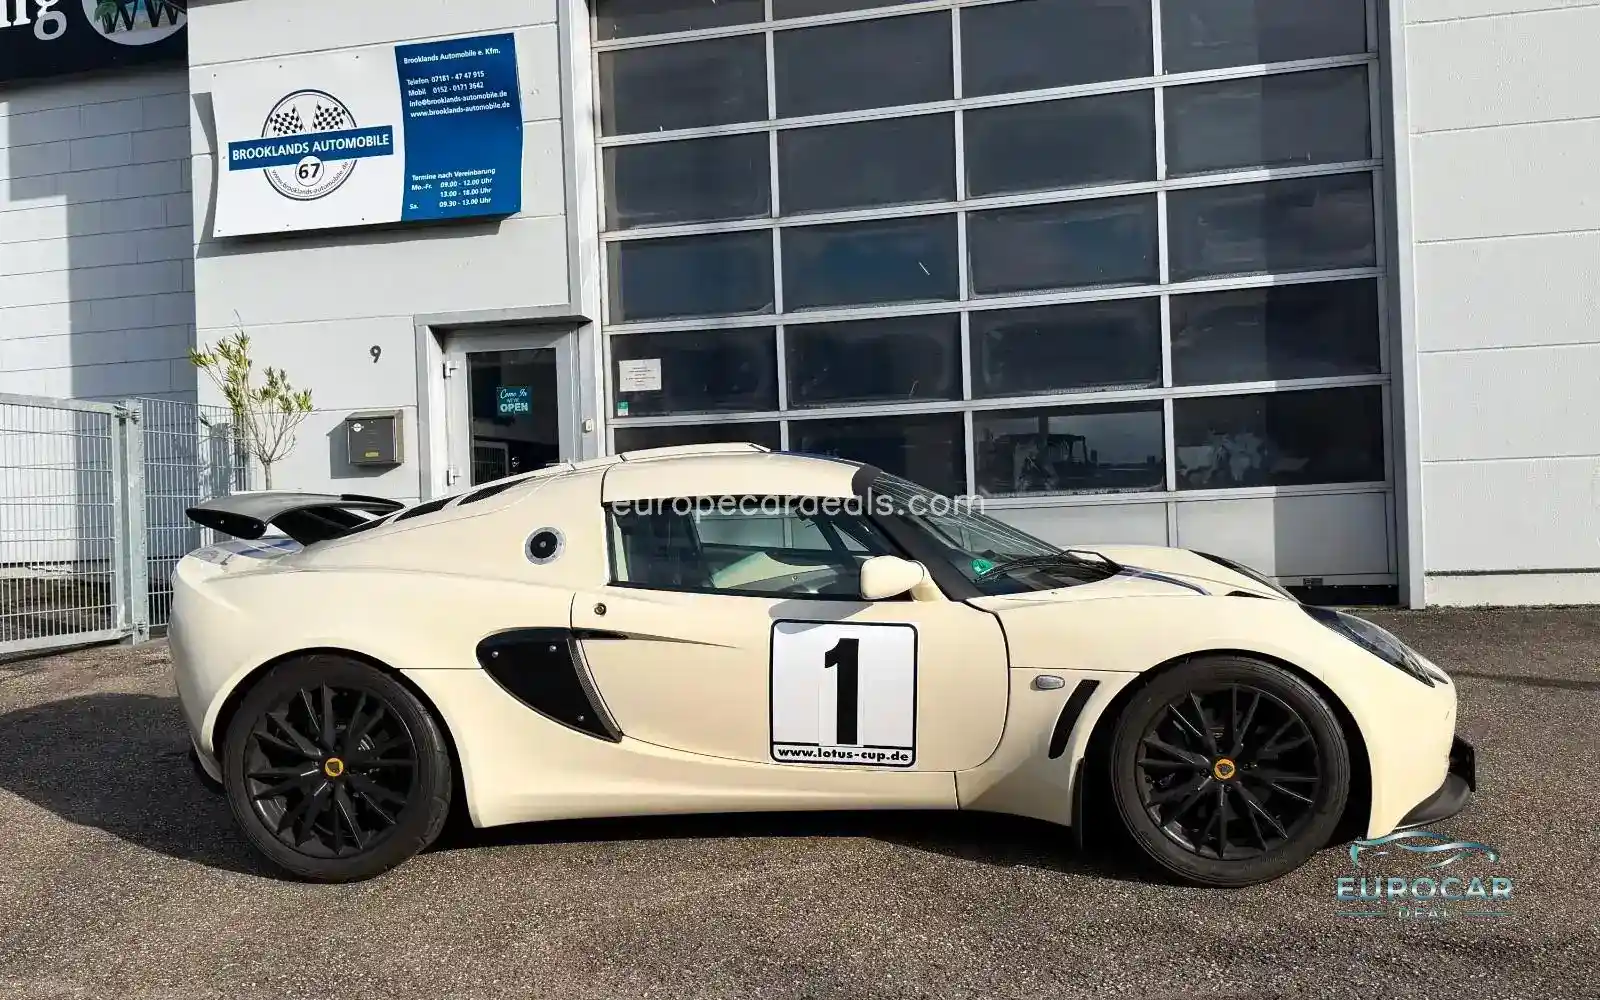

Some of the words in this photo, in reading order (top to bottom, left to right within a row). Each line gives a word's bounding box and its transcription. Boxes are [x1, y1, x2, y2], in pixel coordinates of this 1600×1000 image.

[403, 54, 439, 65] Brooklands
[440, 49, 477, 60] Automobile
[485, 47, 501, 56] Kfm.
[406, 78, 430, 86] Telefon
[431, 75, 450, 83] 07181
[464, 71, 472, 79] 47
[473, 70, 485, 78] 915
[408, 89, 427, 97] Mobil
[432, 85, 448, 94] 0152
[468, 81, 484, 90] 3642
[409, 90, 508, 107] info@brooklands-automobile.de
[410, 101, 511, 118] www.brooklands-automobile.de
[232, 142, 310, 161] BROOKLANDS
[312, 134, 390, 153] AUTOMOBILE
[298, 162, 321, 180] 67
[411, 173, 437, 181] Termine
[437, 171, 453, 179] nach
[453, 168, 496, 178] Vereinbarung
[411, 183, 433, 191] Mo.-Fr.
[440, 180, 458, 188] 09.00
[463, 178, 480, 186] 12.00
[480, 177, 493, 185] Uhr
[440, 190, 457, 198] 13.00
[462, 188, 479, 196] 18.00
[480, 186, 493, 194] Uhr
[439, 200, 457, 208] 09.30
[462, 198, 479, 206] 13.00
[479, 196, 492, 204] Uhr
[370, 345, 382, 364] 9
[500, 402, 528, 412] OPEN
[824, 637, 860, 745] 1
[777, 747, 909, 762] www.lotus-cup.de
